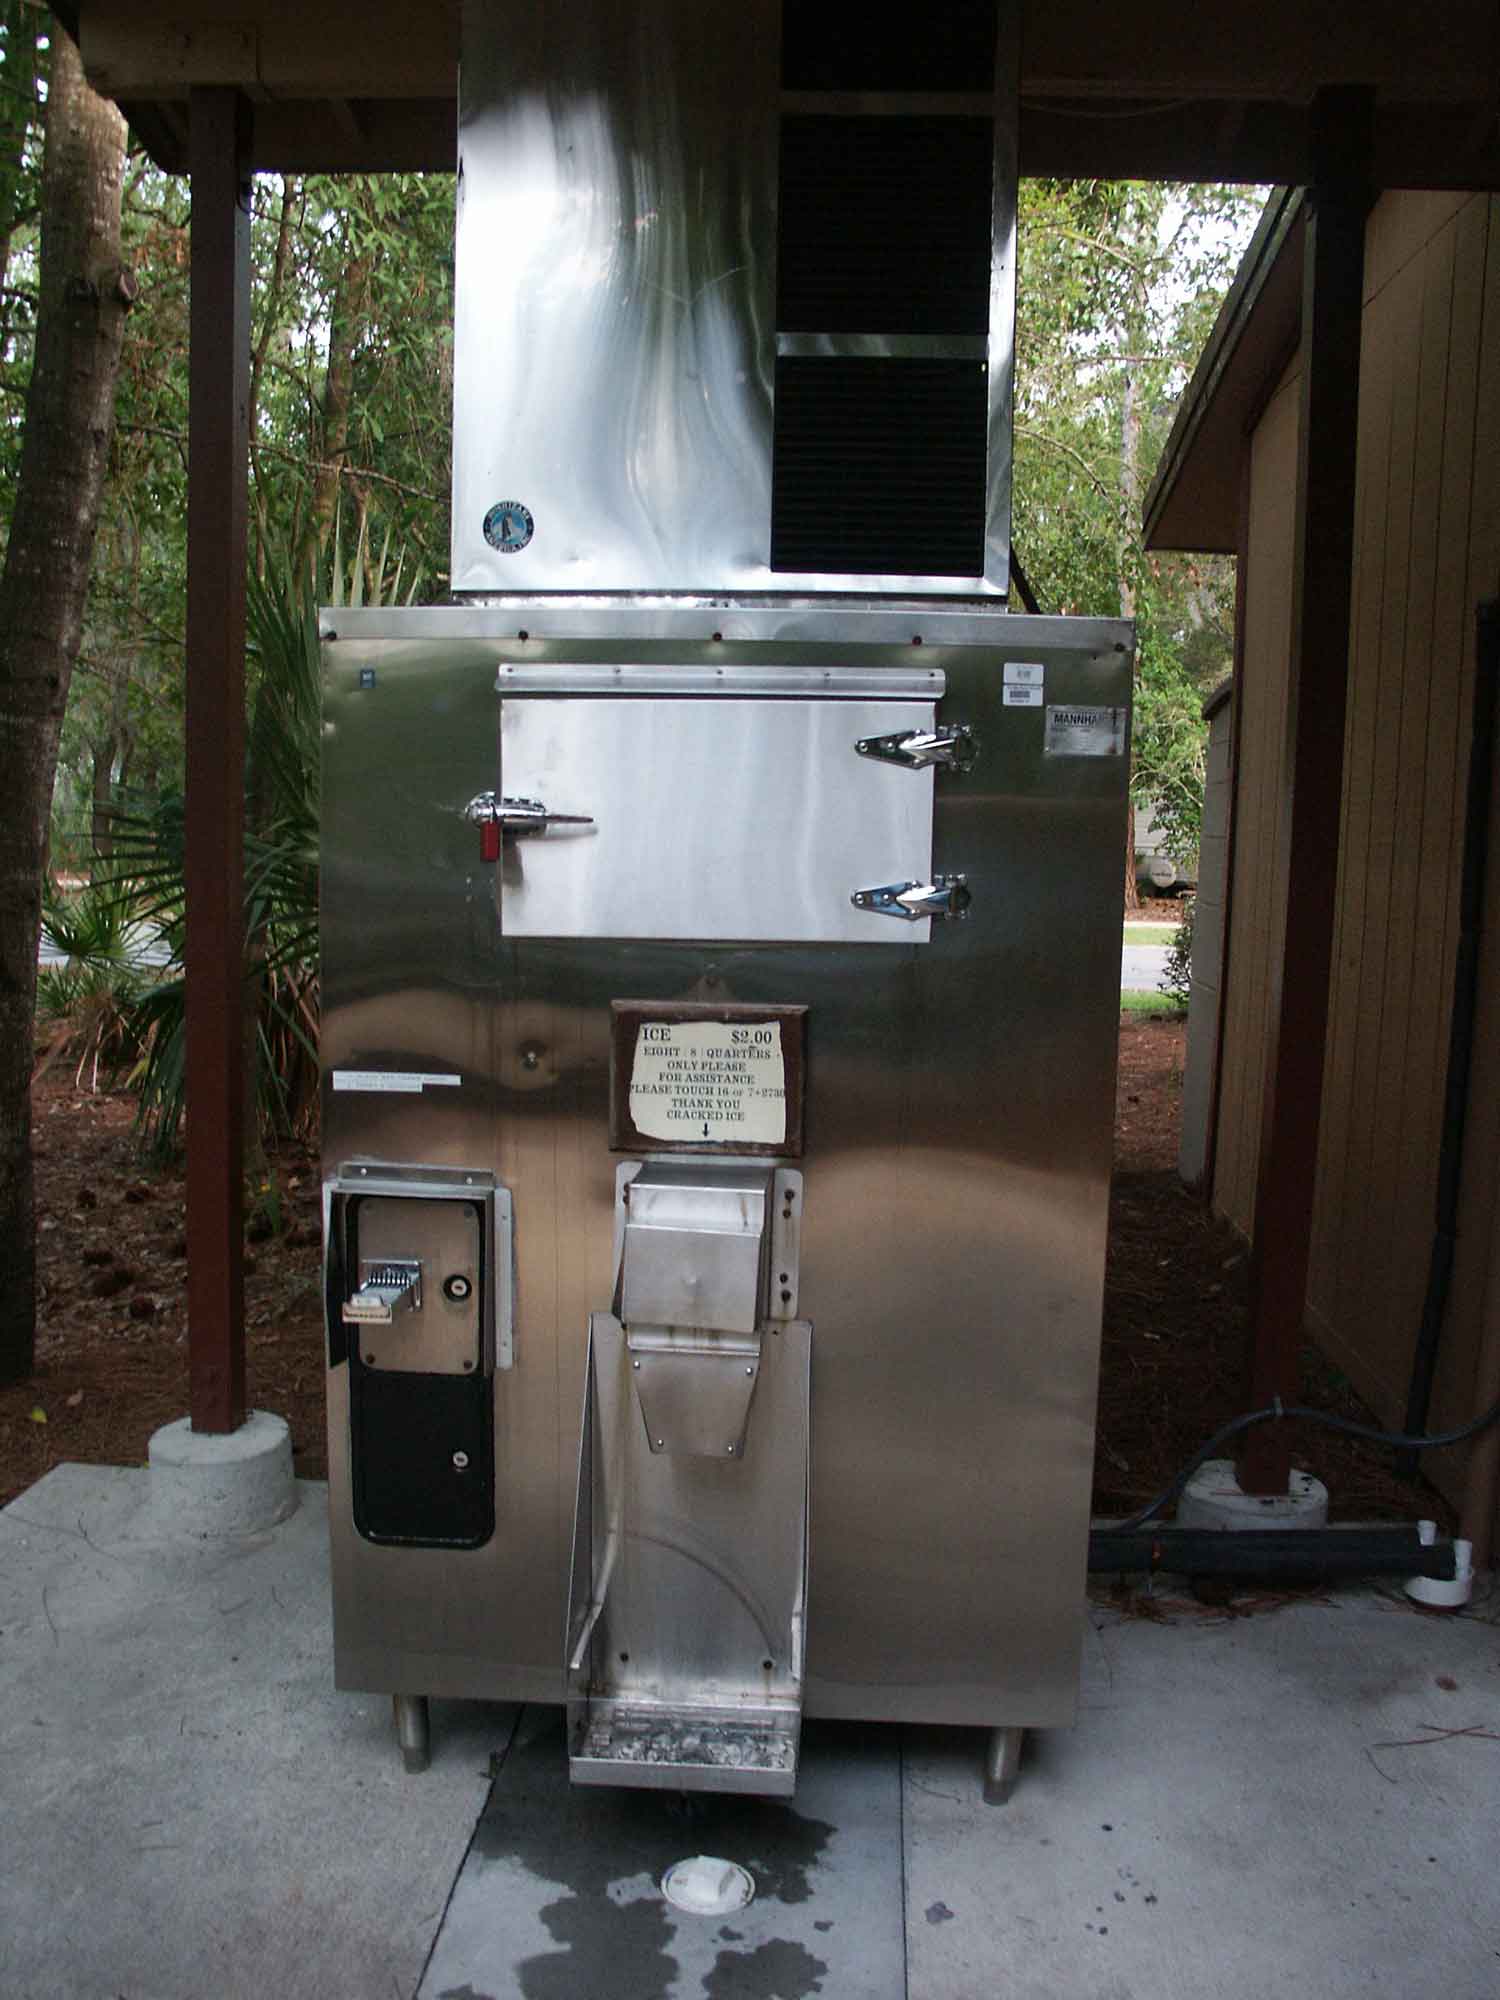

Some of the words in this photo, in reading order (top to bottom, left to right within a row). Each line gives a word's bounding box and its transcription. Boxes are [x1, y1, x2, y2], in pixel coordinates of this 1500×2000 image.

[642, 1027, 671, 1041] ICE
[731, 1030, 772, 1044] $2.00
[644, 1047, 681, 1057] EIGHT
[706, 1048, 771, 1059] QUARTERS
[667, 1061, 698, 1072] ONLY
[700, 1061, 746, 1072] PLEASE
[658, 1073, 683, 1083] FOR
[685, 1074, 755, 1085] ASSISTANCE
[675, 1085, 714, 1096] TOUCH
[671, 1098, 713, 1109] THANK
[716, 1099, 741, 1110] YOU
[666, 1110, 723, 1121] CRACKED
[726, 1111, 745, 1121] ICE
